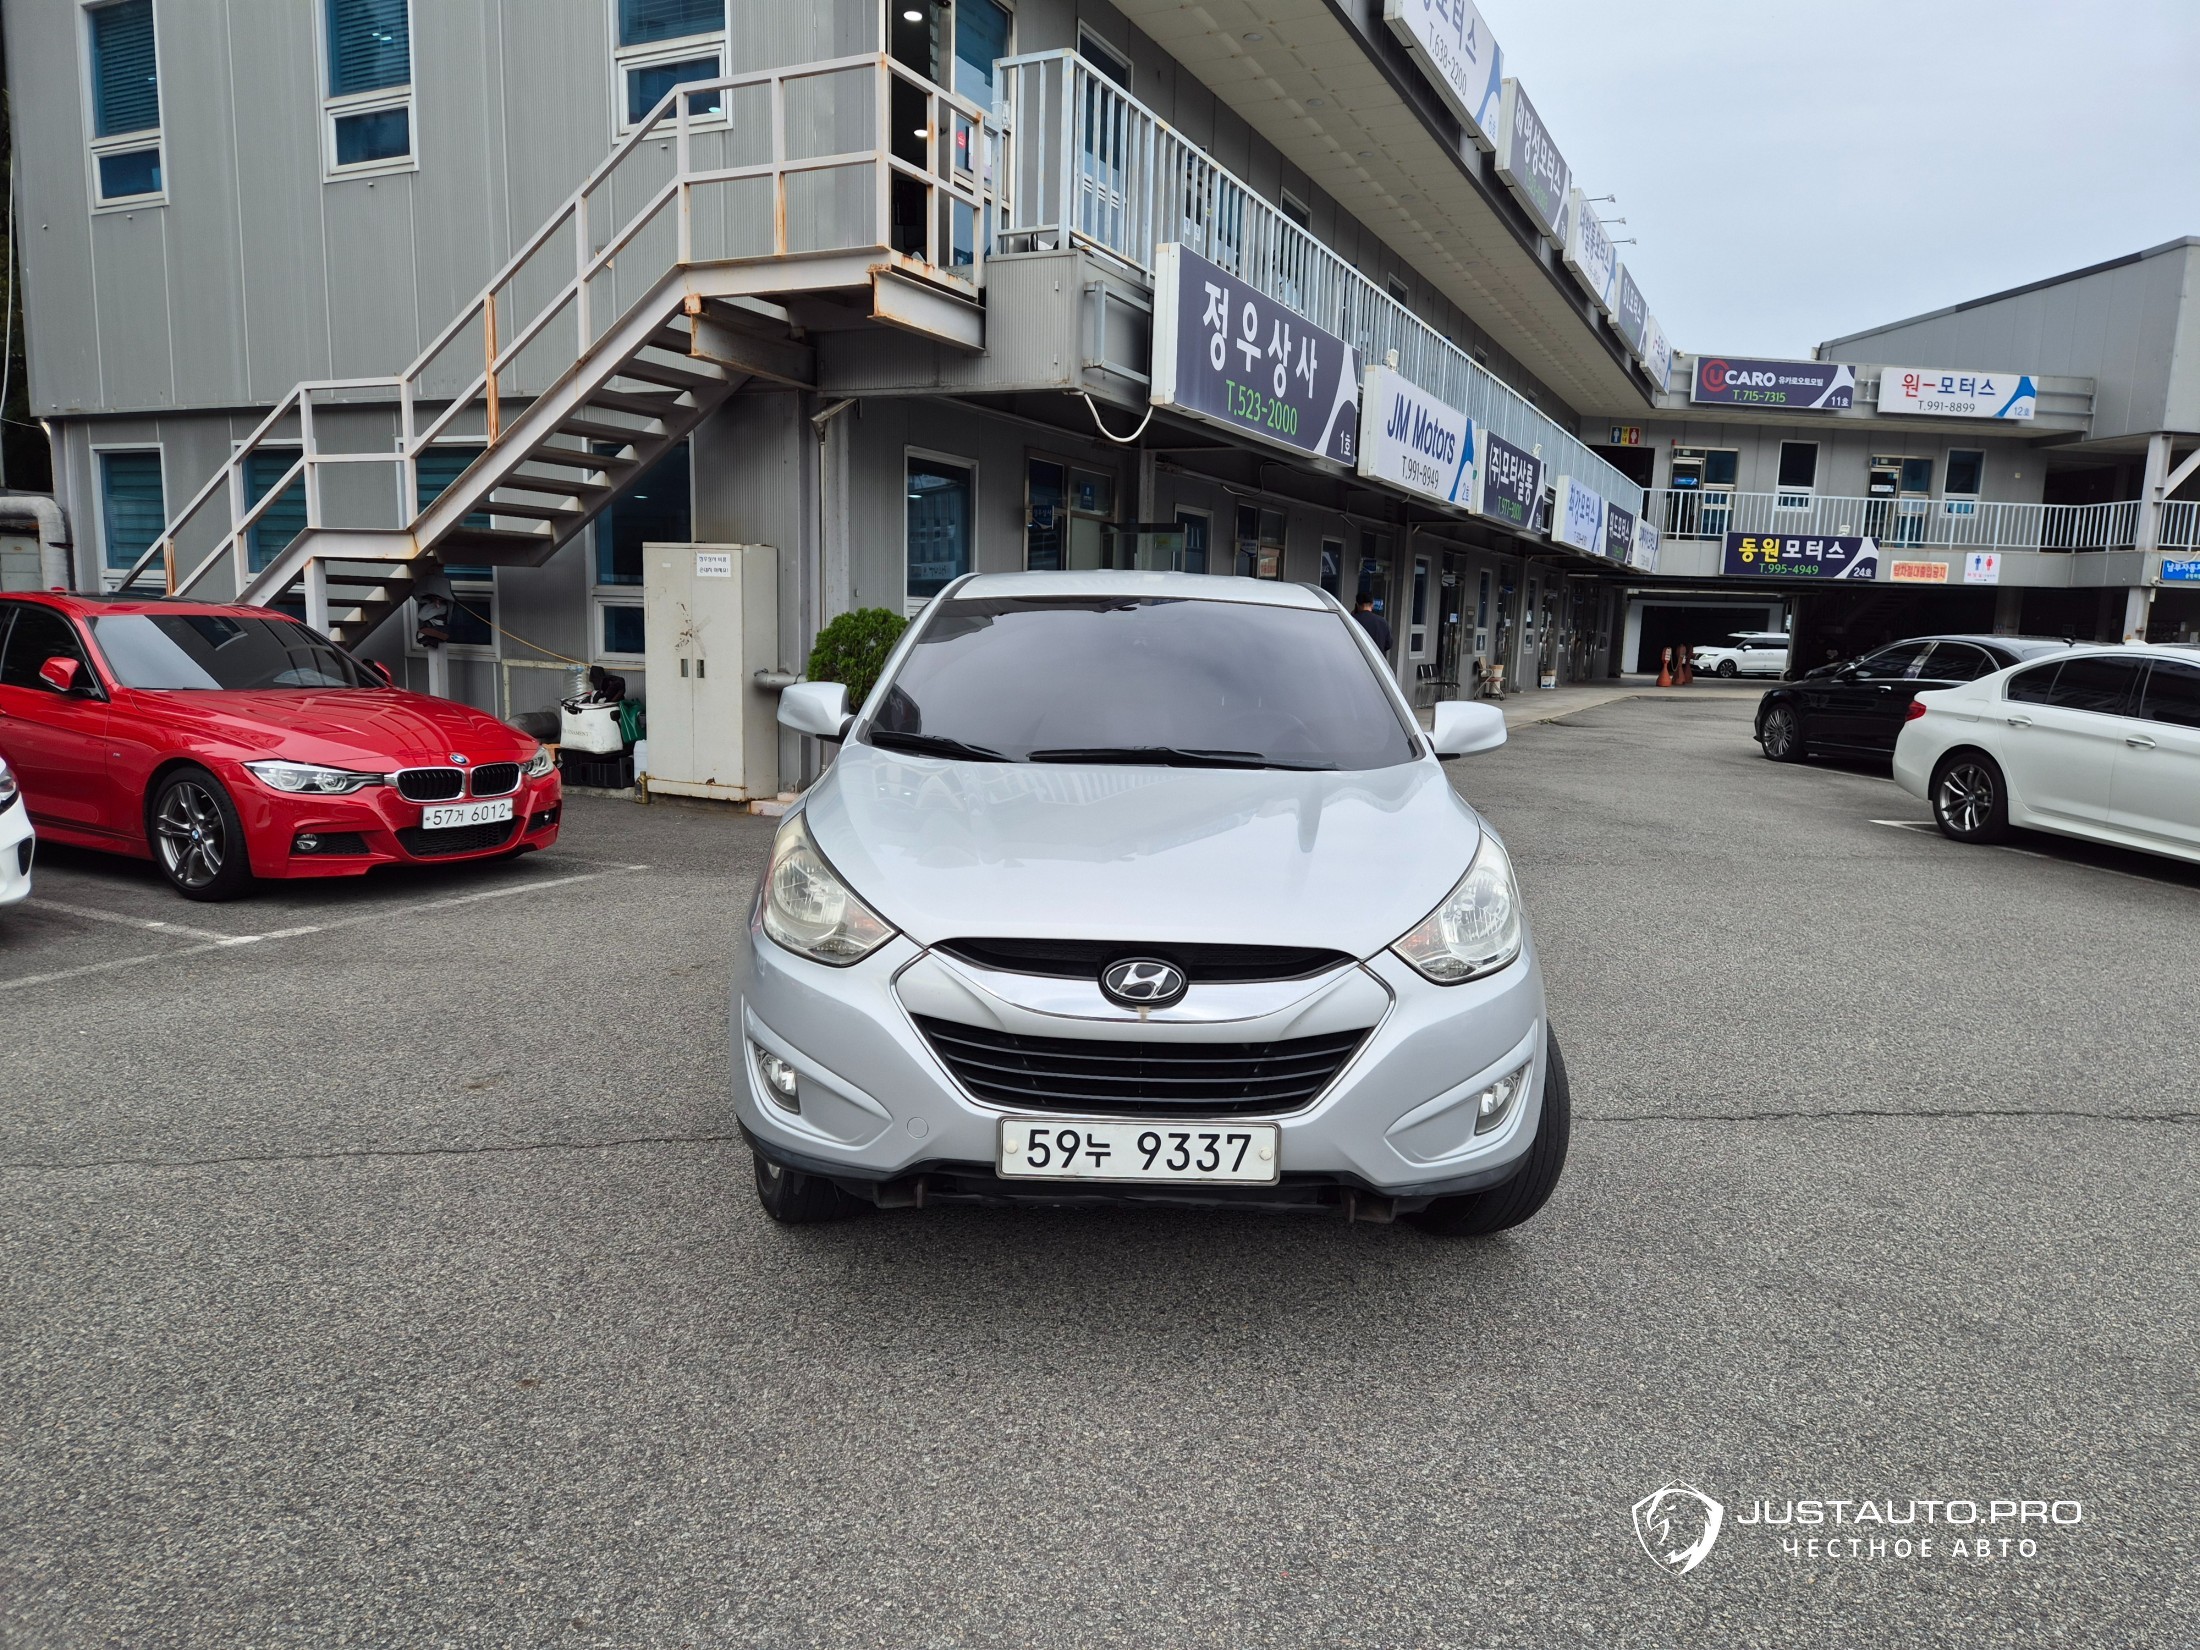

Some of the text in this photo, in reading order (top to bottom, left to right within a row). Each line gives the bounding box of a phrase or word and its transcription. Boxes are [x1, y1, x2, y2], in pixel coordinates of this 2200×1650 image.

[1428, 21, 1467, 96] T.638-2200
[1202, 280, 1318, 399] 정우상사
[1225, 378, 1298, 436] T.523-2000
[1732, 389, 1787, 404] T.715-7315
[1831, 395, 1849, 407] 11호
[1917, 400, 1976, 413] T.991-8899
[2013, 406, 2030, 417] 12호
[1387, 392, 1456, 465] JM Motors
[1340, 430, 1352, 456] 1호
[1401, 455, 1440, 490] T.991-8949
[1489, 442, 1534, 506] (주)모터살롱
[1738, 537, 1846, 563] 동원모터스
[1758, 562, 1819, 575] T.995-4949
[1852, 567, 1873, 577] 24호
[471, 802, 506, 822] 6012
[1026, 1129, 1251, 1172] 59누 9337
